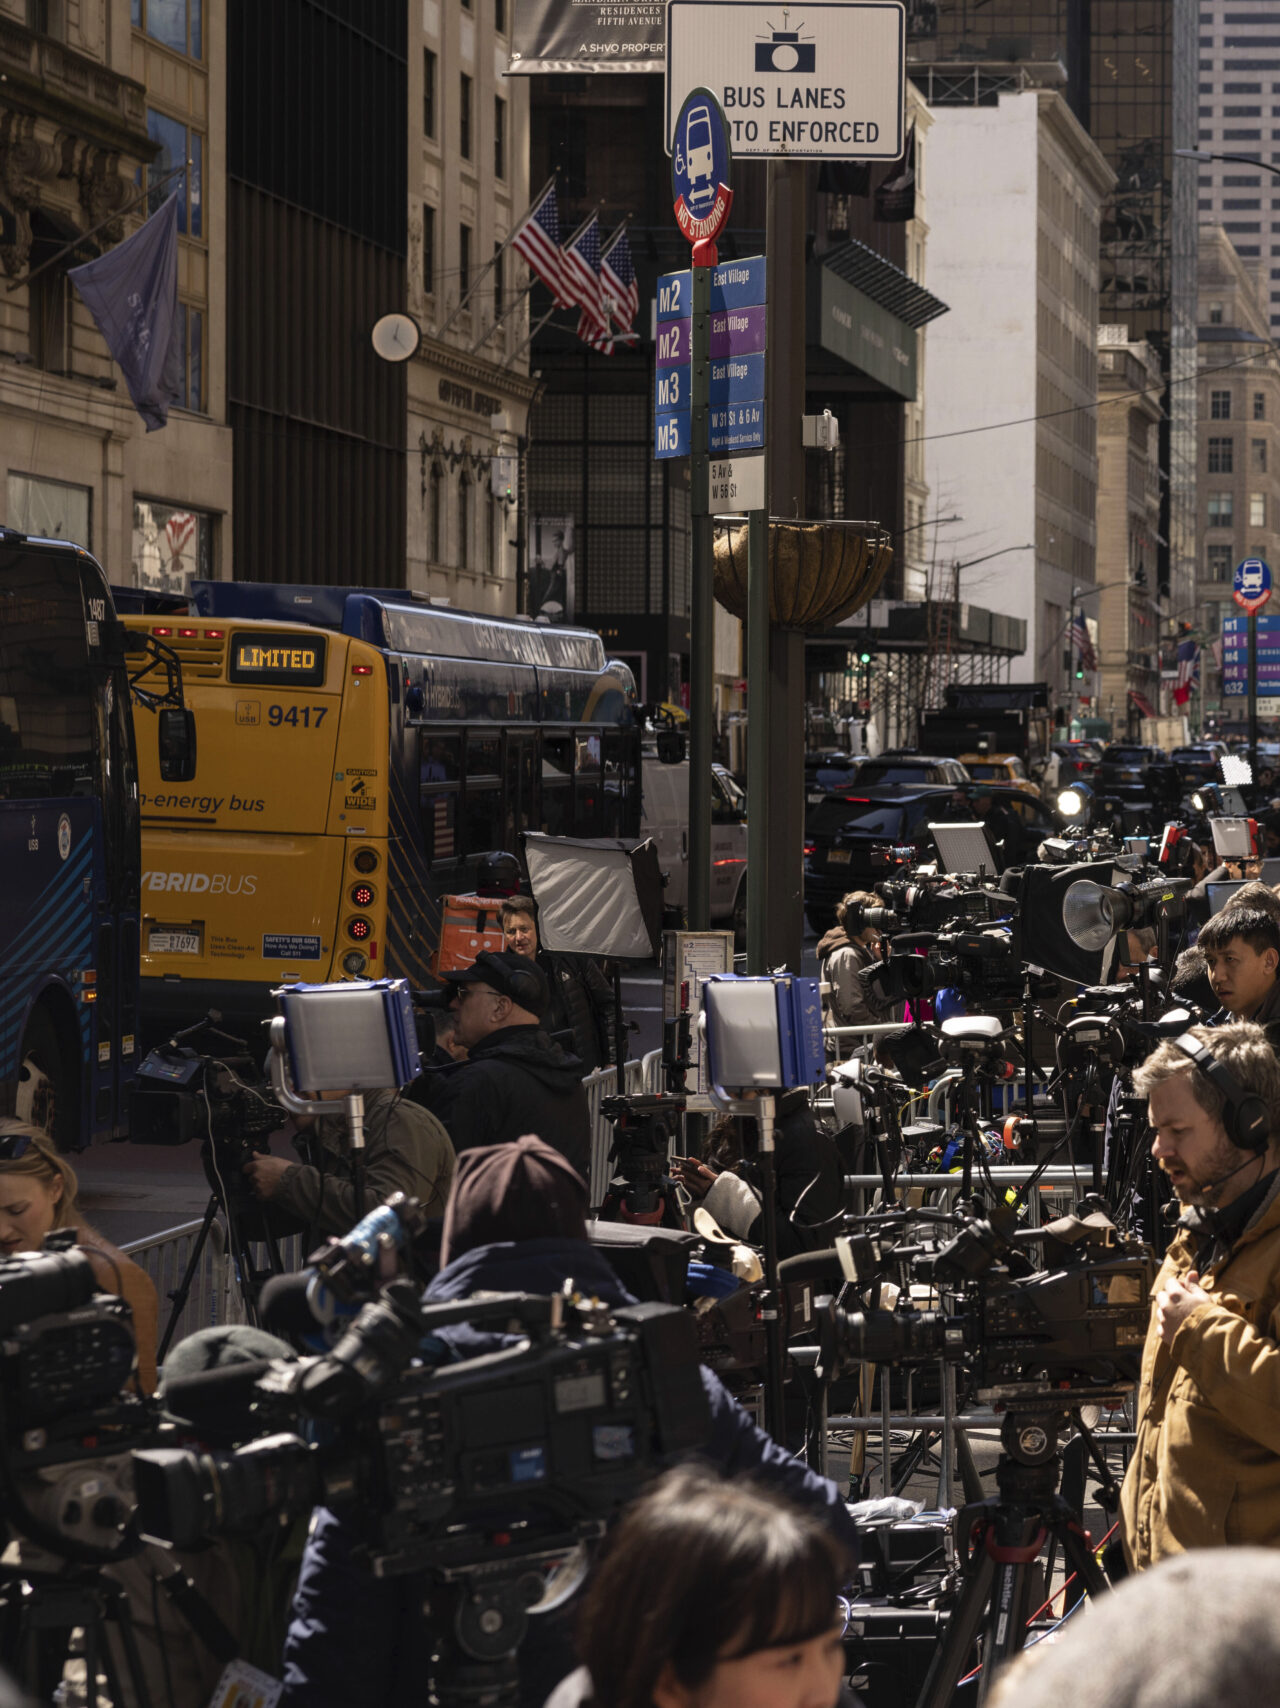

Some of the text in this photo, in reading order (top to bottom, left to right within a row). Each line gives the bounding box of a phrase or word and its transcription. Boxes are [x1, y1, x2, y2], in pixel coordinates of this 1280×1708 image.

[600, 6, 661, 15] RESIDENCES
[597, 17, 662, 26] FIFTH AVENUE
[579, 44, 587, 52] A
[723, 86, 846, 109] BUS LANES
[769, 121, 879, 143] ENFORCED
[678, 196, 725, 238] NO STANDING
[713, 268, 749, 287] East Village
[660, 280, 680, 313] M2
[713, 316, 749, 333] East Village
[659, 326, 680, 359] M2
[712, 363, 748, 380] East Village
[658, 372, 679, 405] M3
[711, 408, 760, 428] W 31 St & 6 Av
[658, 419, 679, 451] M5
[712, 463, 733, 479] 5 Av &
[712, 485, 718, 499] W
[730, 483, 737, 498] St
[88, 598, 105, 621] 1487
[1224, 619, 1237, 631] M1
[1224, 635, 1237, 647] M1
[239, 648, 315, 669] LIMITED
[1224, 650, 1238, 662] M4
[1224, 666, 1238, 678] M4
[239, 705, 328, 728] USB 9417
[229, 794, 265, 812] bus
[346, 797, 375, 806] WIDE
[28, 839, 39, 851] USB
